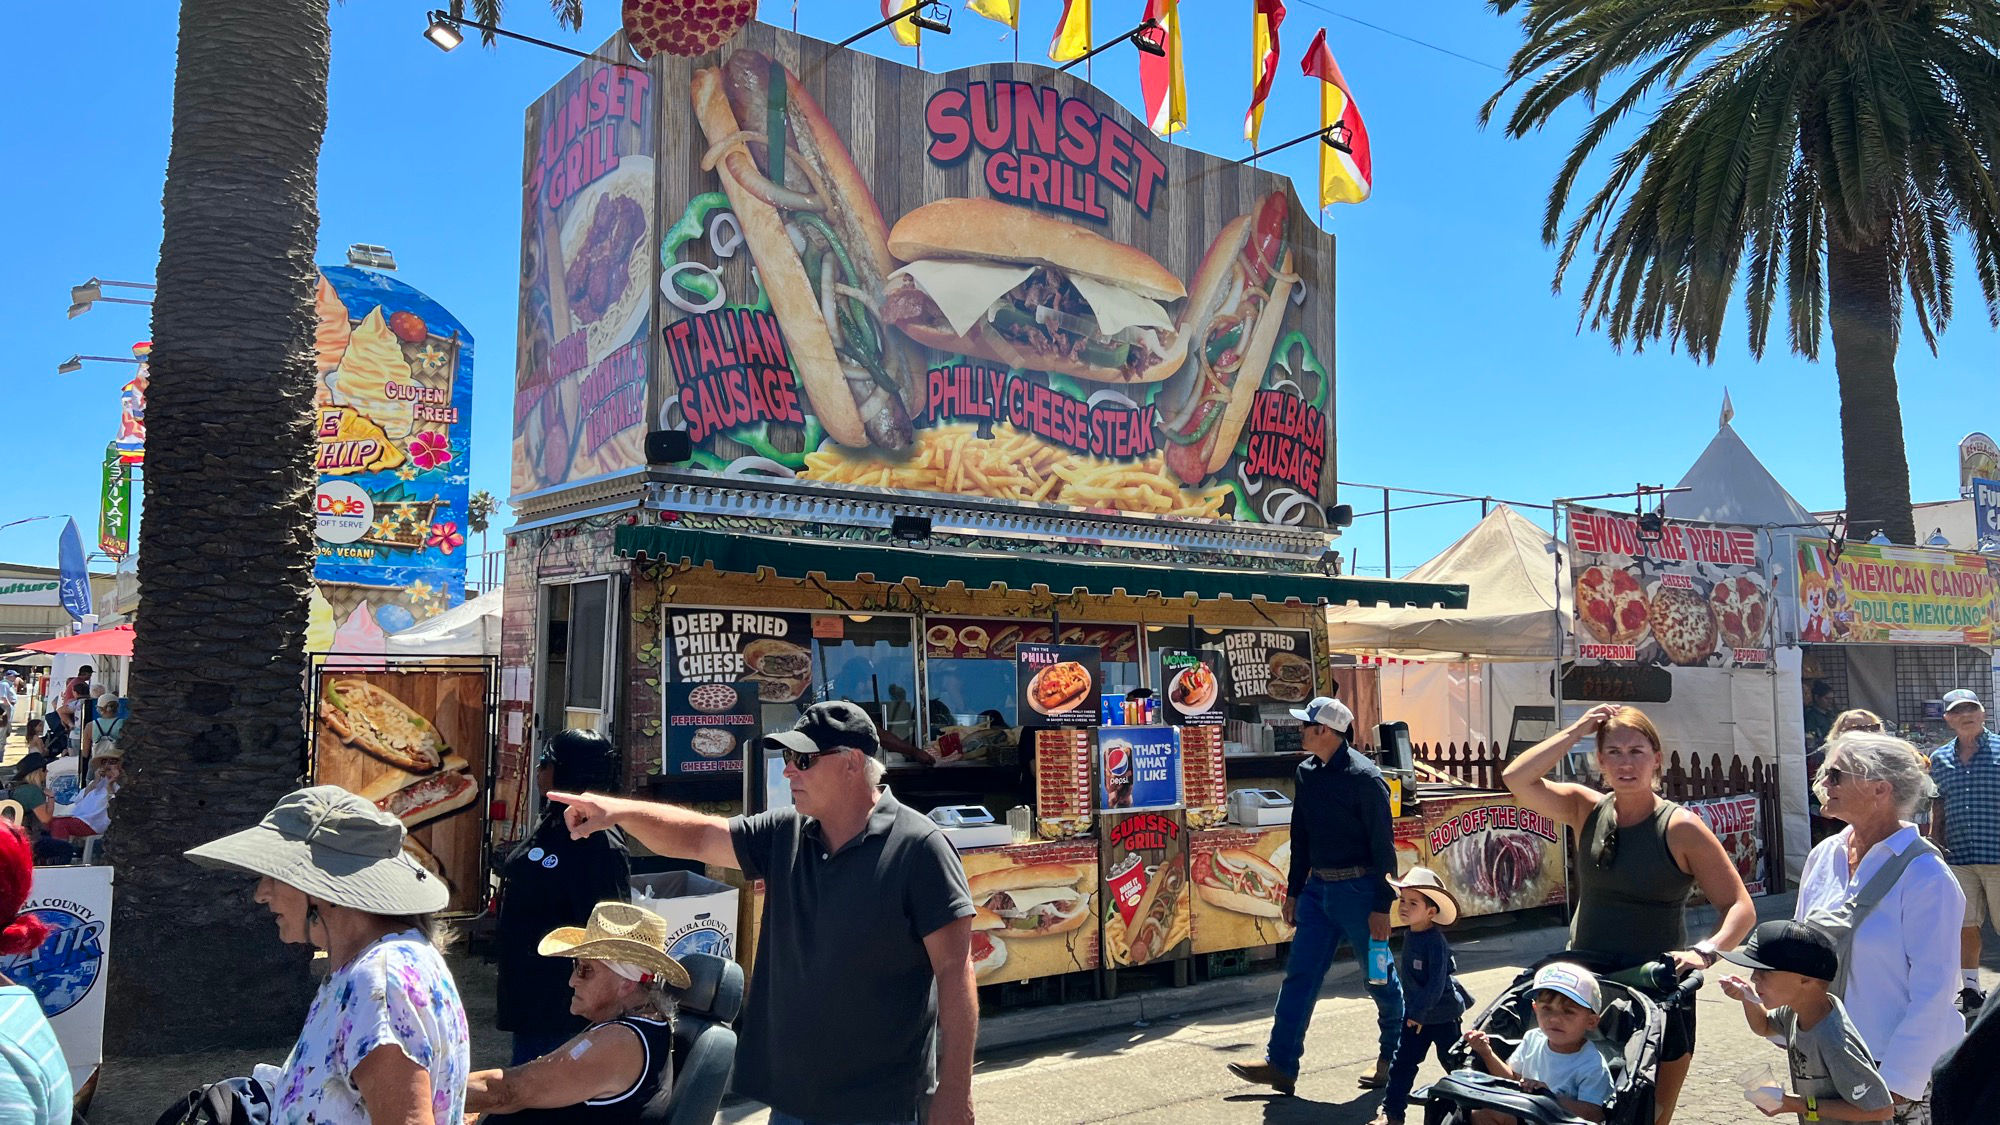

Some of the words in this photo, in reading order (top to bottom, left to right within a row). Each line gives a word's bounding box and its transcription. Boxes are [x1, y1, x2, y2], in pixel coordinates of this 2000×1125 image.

[527, 64, 649, 207] SUNSET
[925, 81, 1166, 213] SUNSET
[550, 124, 620, 210] GRILL
[984, 151, 1105, 219] GRILL
[665, 309, 787, 385] ITALIAN
[384, 381, 444, 404] GLUTEN
[580, 343, 634, 421] SPAGHETTI
[413, 404, 458, 424] FREE!
[680, 366, 805, 443] SAUSAGE
[928, 366, 1006, 422] PHILLY
[1008, 378, 1088, 451] CHEESE
[1090, 406, 1155, 457] STEAK
[586, 381, 642, 456] MEATBALLS
[1250, 391, 1326, 458] KIELBASA
[1245, 434, 1321, 497] SAUSAGE
[339, 520, 363, 529] SERVE
[337, 547, 374, 558] VEGAN!
[1690, 526, 1742, 564] PIZZA
[1661, 574, 1692, 589] CHEESE
[672, 613, 725, 635] DEEP
[732, 613, 788, 637] FRIED
[675, 632, 741, 657] PHILLY
[1225, 632, 1256, 650] DEEP
[1260, 632, 1295, 651] FRIED
[1579, 644, 1636, 660] PEPPERONI
[678, 653, 744, 676] CHEESE
[1021, 652, 1059, 663] PHILLY
[1228, 648, 1267, 666] PHILLY
[1231, 663, 1271, 681] CHEESE
[1234, 680, 1267, 698] STEAK
[671, 716, 725, 726] PEPPERONI
[726, 715, 754, 725] PIZZA
[1133, 744, 1172, 756] THAT'S
[681, 761, 717, 771] CHEESE
[1135, 757, 1167, 769] WHAT
[1109, 776, 1129, 786] pepsi
[1137, 771, 1141, 781] I
[1143, 769, 1167, 781] LIKE
[1110, 814, 1179, 848] SUNSET
[1124, 832, 1166, 851] GRILL
[1429, 817, 1459, 855] HOT
[1461, 808, 1487, 835] OFF
[1489, 806, 1517, 828] THE
[1519, 809, 1557, 842] GRILL
[42, 898, 96, 920] COUNTY
[663, 922, 699, 951] ENTURA
[701, 919, 729, 933] COUNTY
